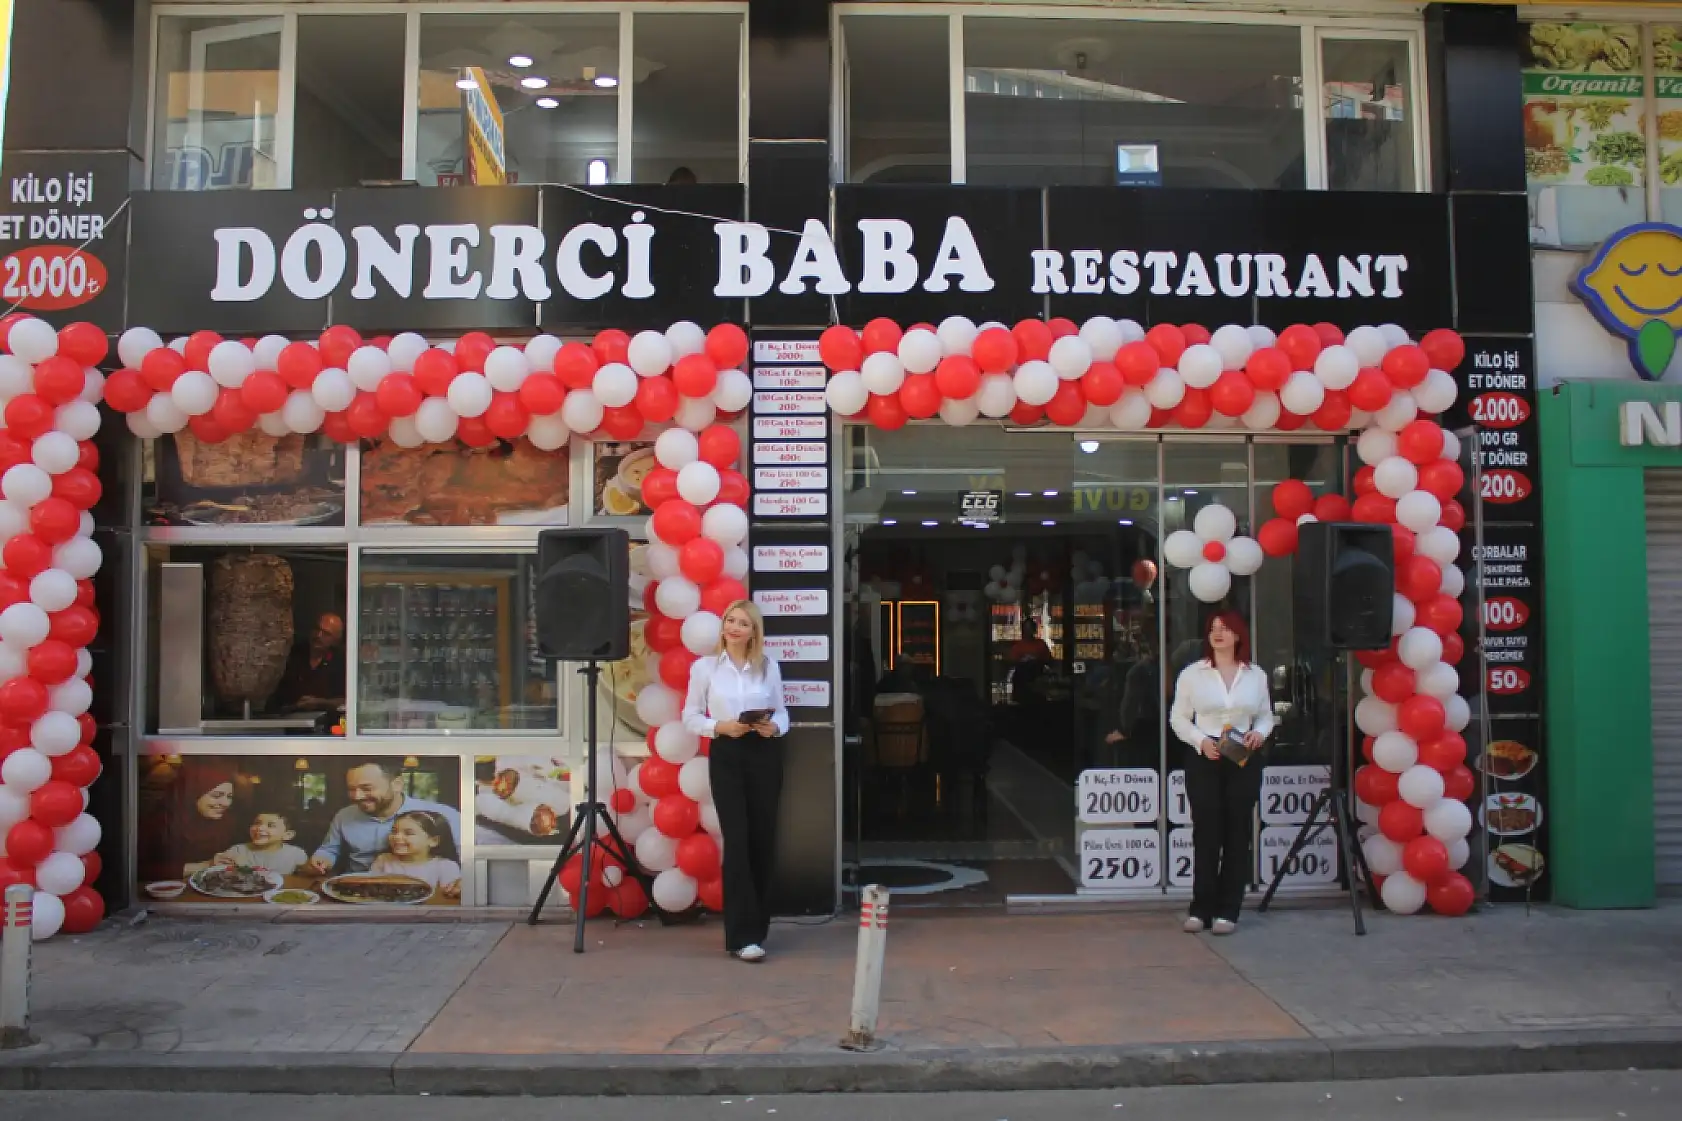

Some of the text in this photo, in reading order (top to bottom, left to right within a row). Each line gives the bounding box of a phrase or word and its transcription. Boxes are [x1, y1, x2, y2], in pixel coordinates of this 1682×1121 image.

[1542, 76, 1642, 93] Organik
[11, 172, 93, 207] KİLO İŞİ
[0, 208, 104, 239] ET DÖNER
[210, 207, 1408, 302] DÖNERCİ BABA RESTAURANT
[1475, 350, 1519, 371] KİLO İŞİ
[1468, 371, 1527, 389] ET DÖNER
[1480, 431, 1518, 446] 100 GR
[1488, 448, 1528, 466] DÖNER
[1086, 791, 1152, 814] 2000₺
[1088, 856, 1153, 880] 250₺
